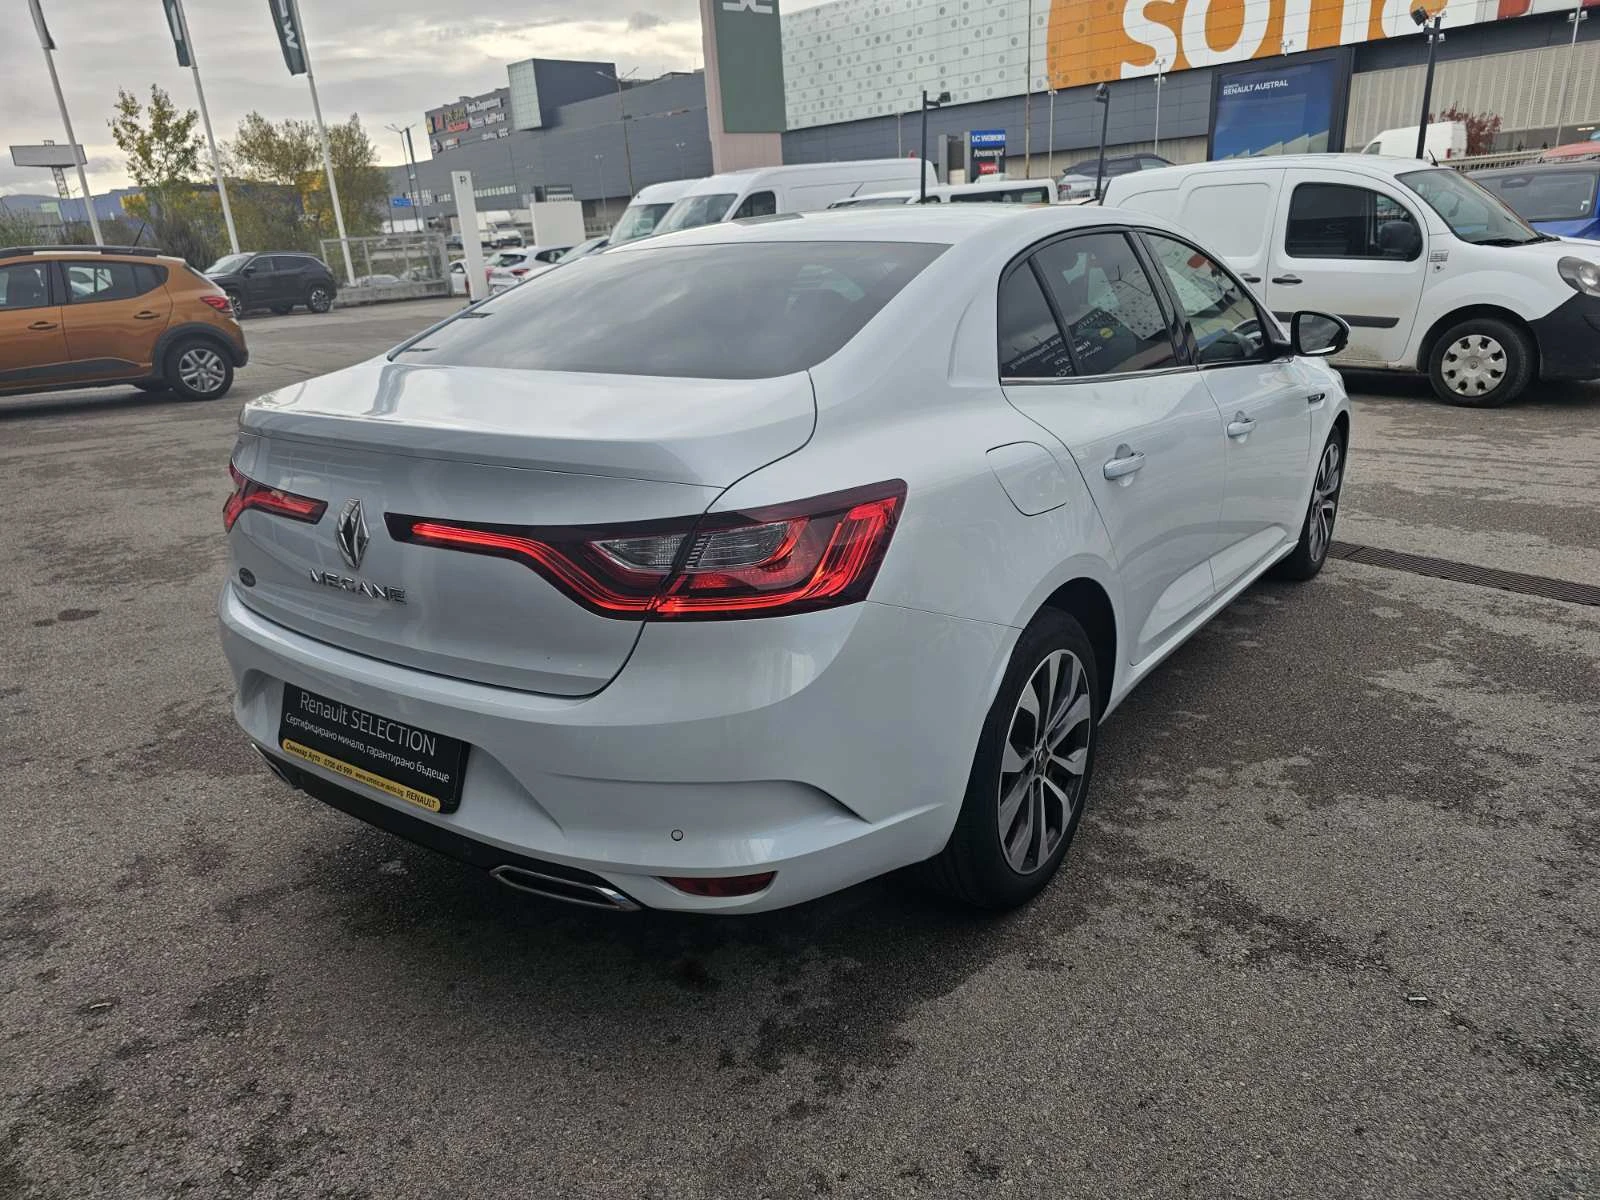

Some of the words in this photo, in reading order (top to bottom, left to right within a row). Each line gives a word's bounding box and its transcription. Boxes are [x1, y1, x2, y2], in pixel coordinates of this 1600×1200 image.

[1223, 83, 1255, 96] RENAULT
[1254, 79, 1288, 91] AUSTRAL
[309, 567, 407, 605] MEGANE
[300, 691, 349, 726] Renault
[350, 710, 436, 757] SELECTION
[285, 712, 338, 741] Сертифицирано
[337, 735, 366, 754] минало,
[366, 744, 416, 770] гарантирано
[416, 761, 450, 783] бъдеще
[406, 790, 437, 809] RENAULT
